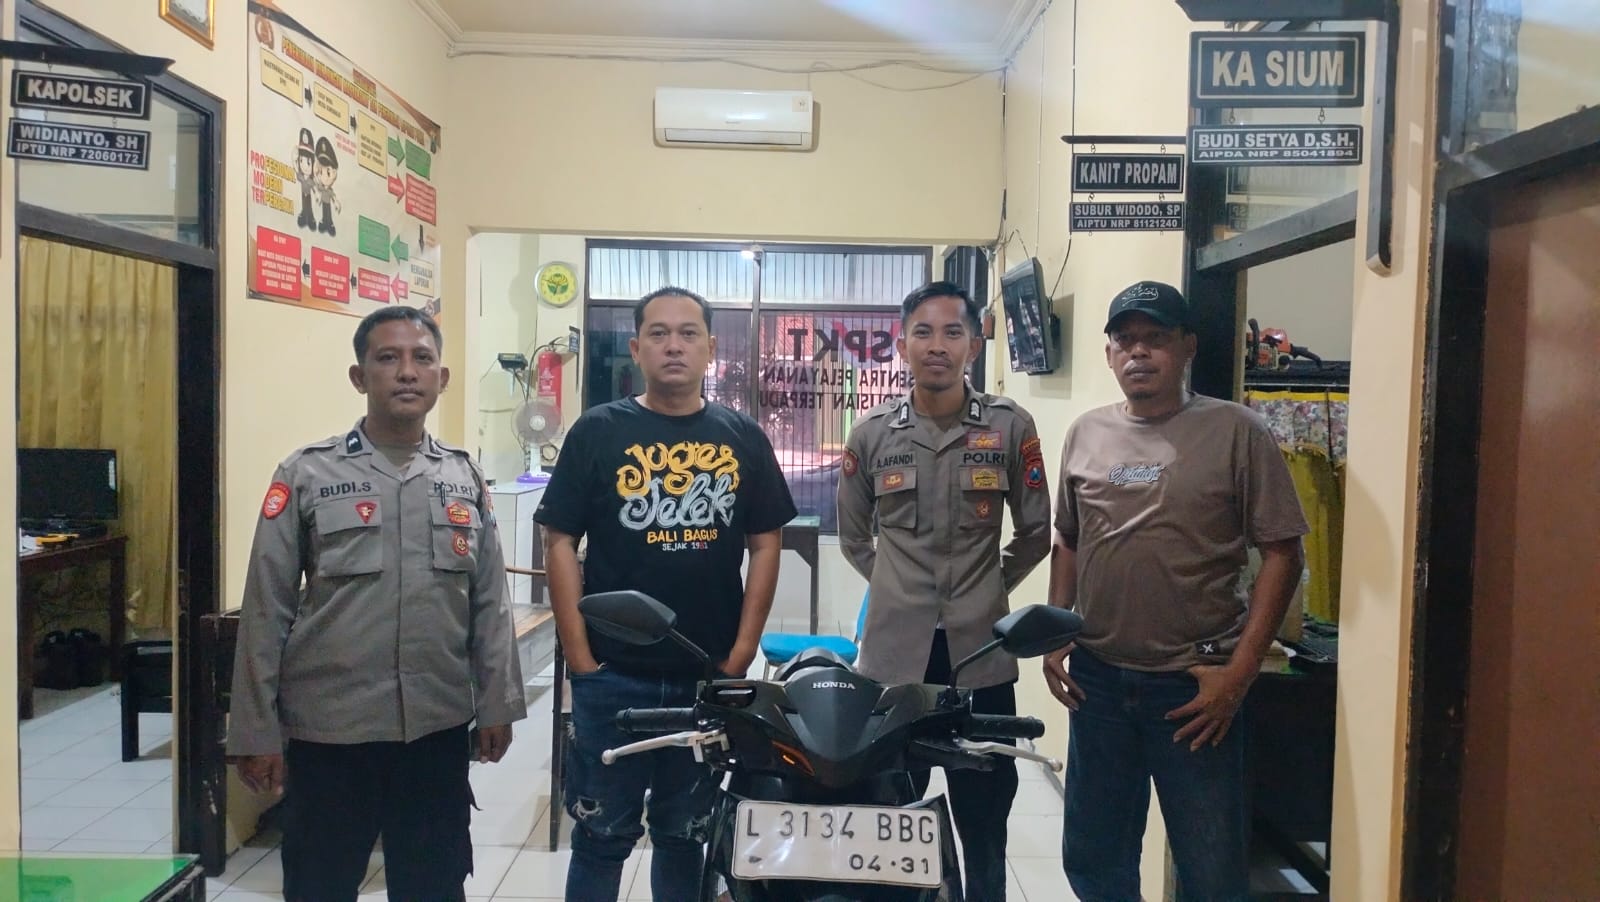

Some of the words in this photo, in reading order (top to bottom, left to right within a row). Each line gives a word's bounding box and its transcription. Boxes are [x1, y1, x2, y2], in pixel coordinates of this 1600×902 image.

[1212, 51, 1256, 87] KA
[1265, 50, 1344, 87] SIUM
[27, 79, 133, 109] KAPOLSEK
[20, 125, 110, 148] WIDIANTO,
[115, 135, 138, 149] SH
[1199, 133, 1240, 147] BUDI
[1245, 133, 1299, 147] SETYA
[16, 143, 46, 155] IPTU
[50, 147, 76, 158] NRP
[80, 149, 139, 164] 72060172
[1199, 150, 1244, 158] AIPDA
[1248, 150, 1279, 158] NRP
[1080, 162, 1120, 184] KANIT
[1125, 163, 1177, 184] PROPAM
[1075, 204, 1111, 216] SUBUR
[1116, 204, 1162, 218] WIDODO,
[1167, 204, 1180, 216] SP
[1077, 219, 1107, 228] AIPTU
[1111, 219, 1130, 228] NRP
[1134, 219, 1178, 228] 81121240
[877, 453, 913, 468] A.AFANDI
[964, 453, 1006, 464] POLRI
[320, 482, 372, 498] BUDI.S
[647, 530, 678, 544] BALI
[684, 529, 718, 542] BAGUS
[662, 542, 688, 552] SEJAK
[813, 681, 856, 690] HONDA
[747, 809, 759, 837] L
[779, 810, 854, 839] 3134
[877, 812, 934, 843] BBG
